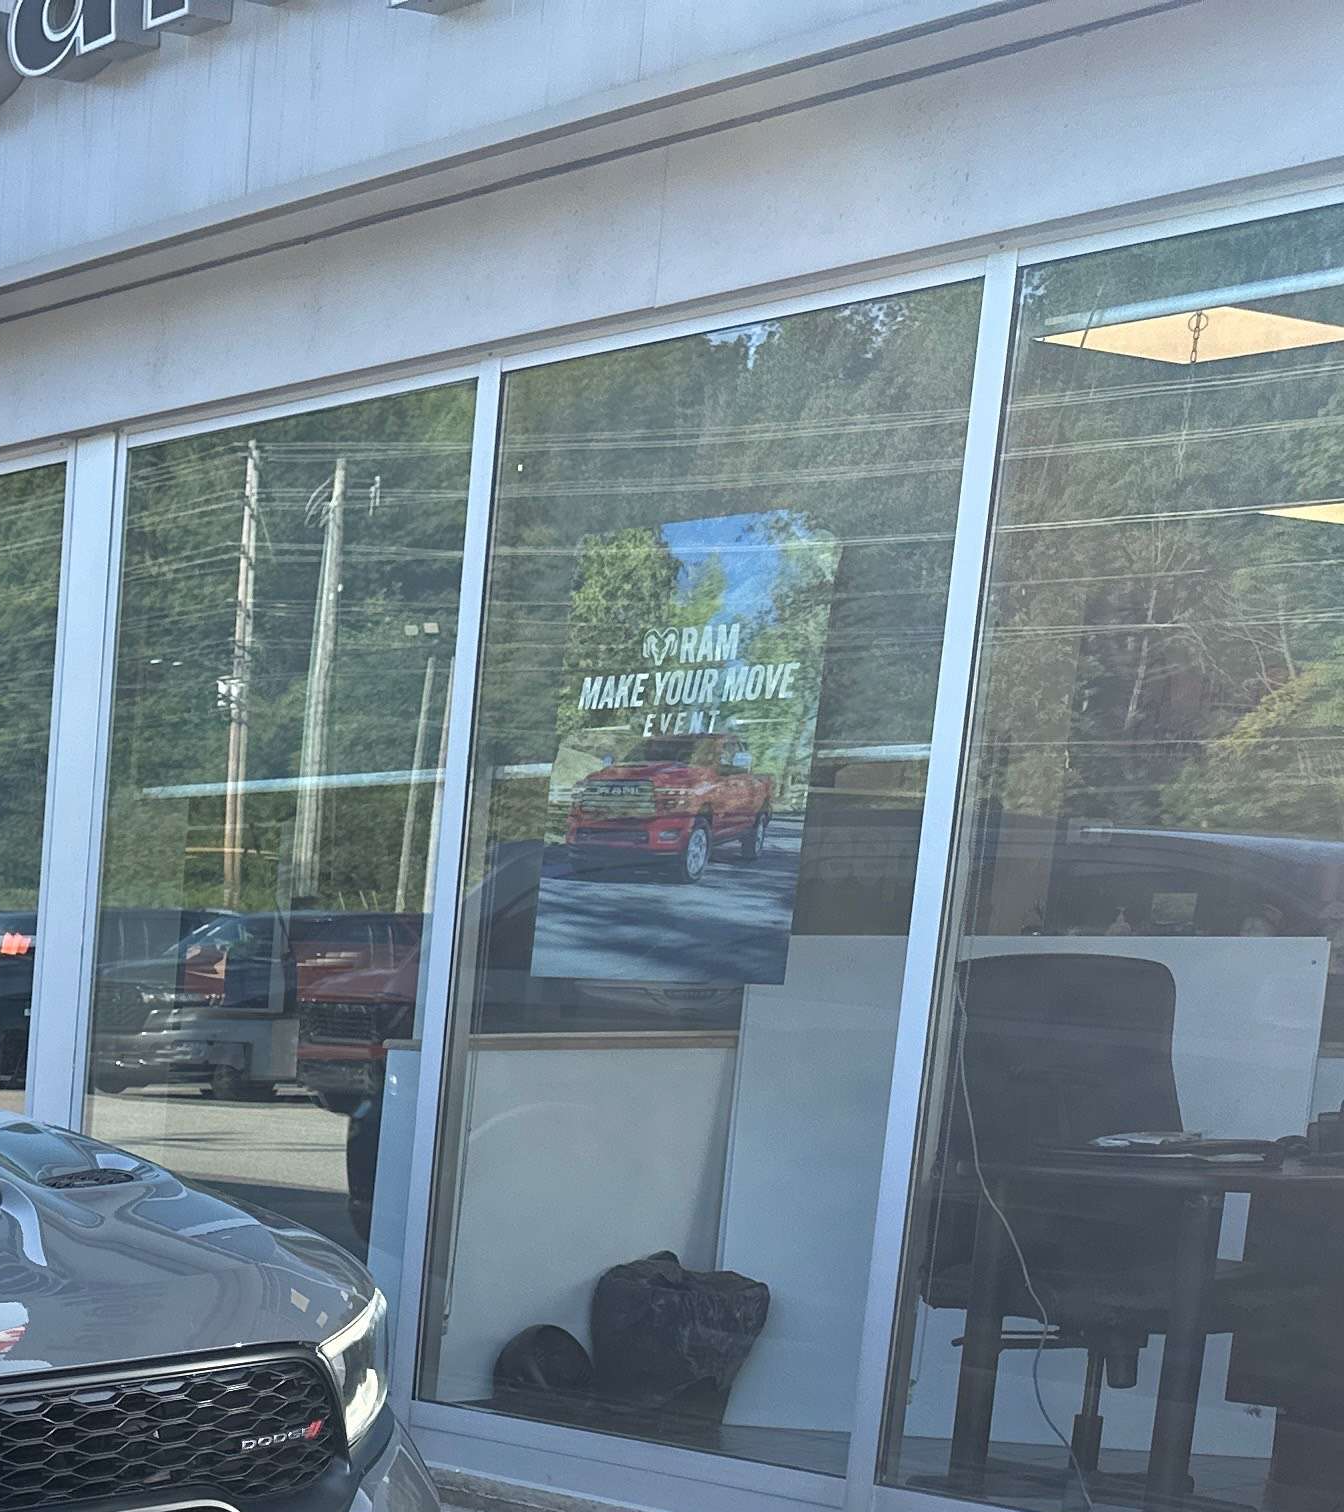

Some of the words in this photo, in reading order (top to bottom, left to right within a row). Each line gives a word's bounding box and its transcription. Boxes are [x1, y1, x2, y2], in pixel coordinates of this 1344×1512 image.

[680, 623, 740, 664] RAM
[578, 673, 649, 710] MAKE
[654, 668, 718, 705] YOUR
[722, 662, 801, 702] MOVE
[643, 710, 720, 737] EVENT
[241, 1424, 310, 1451] DODGE
